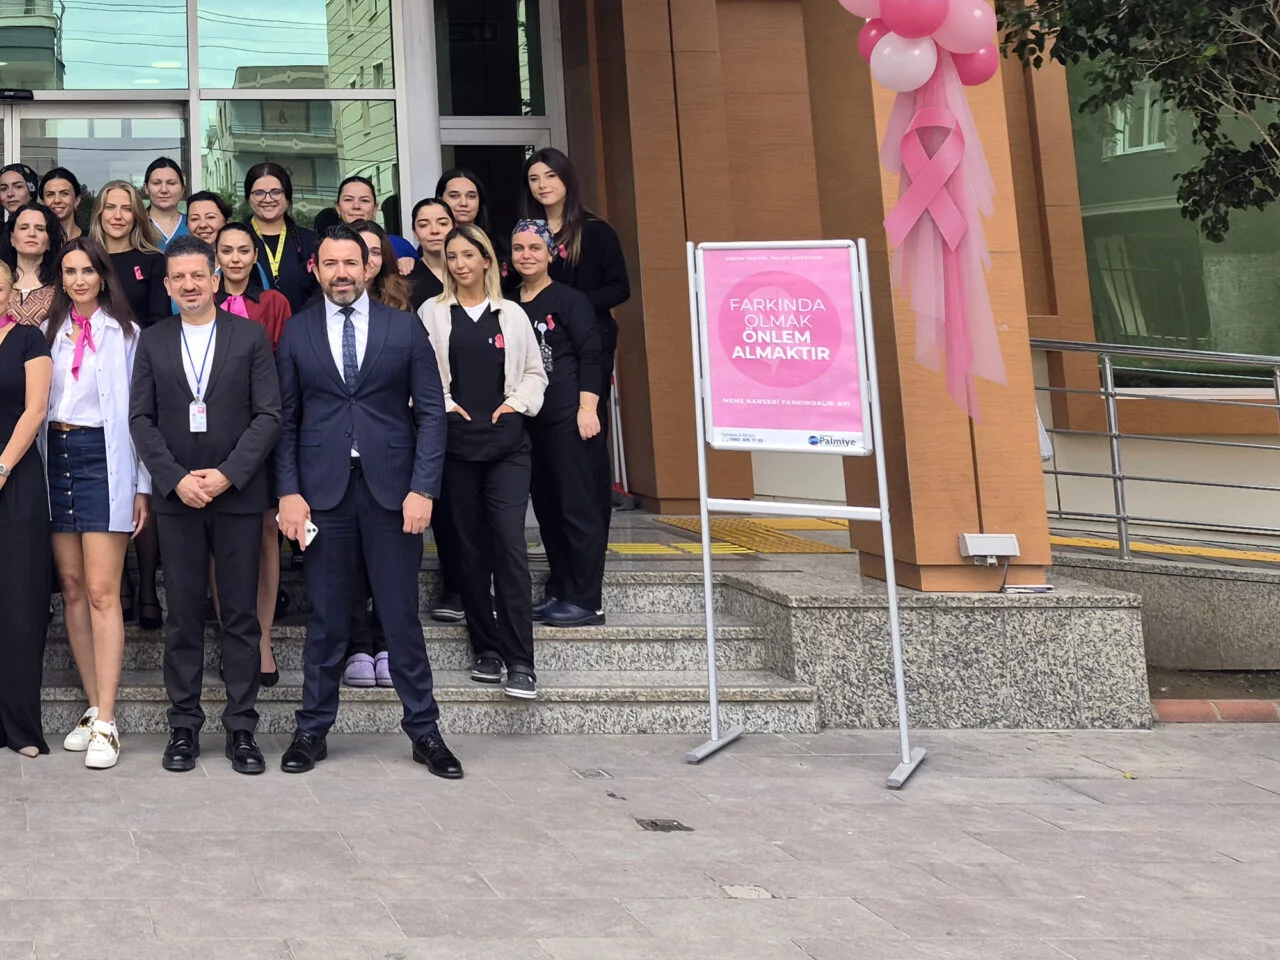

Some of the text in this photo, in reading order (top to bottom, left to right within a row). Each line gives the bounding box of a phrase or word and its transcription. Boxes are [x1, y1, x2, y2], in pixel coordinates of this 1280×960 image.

[730, 298, 826, 312] FARKINDA
[744, 313, 812, 328] OLMAK
[742, 327, 811, 344] ÖNLEM
[732, 346, 830, 360] ALMAKTIR
[819, 436, 857, 446] Palmiye
